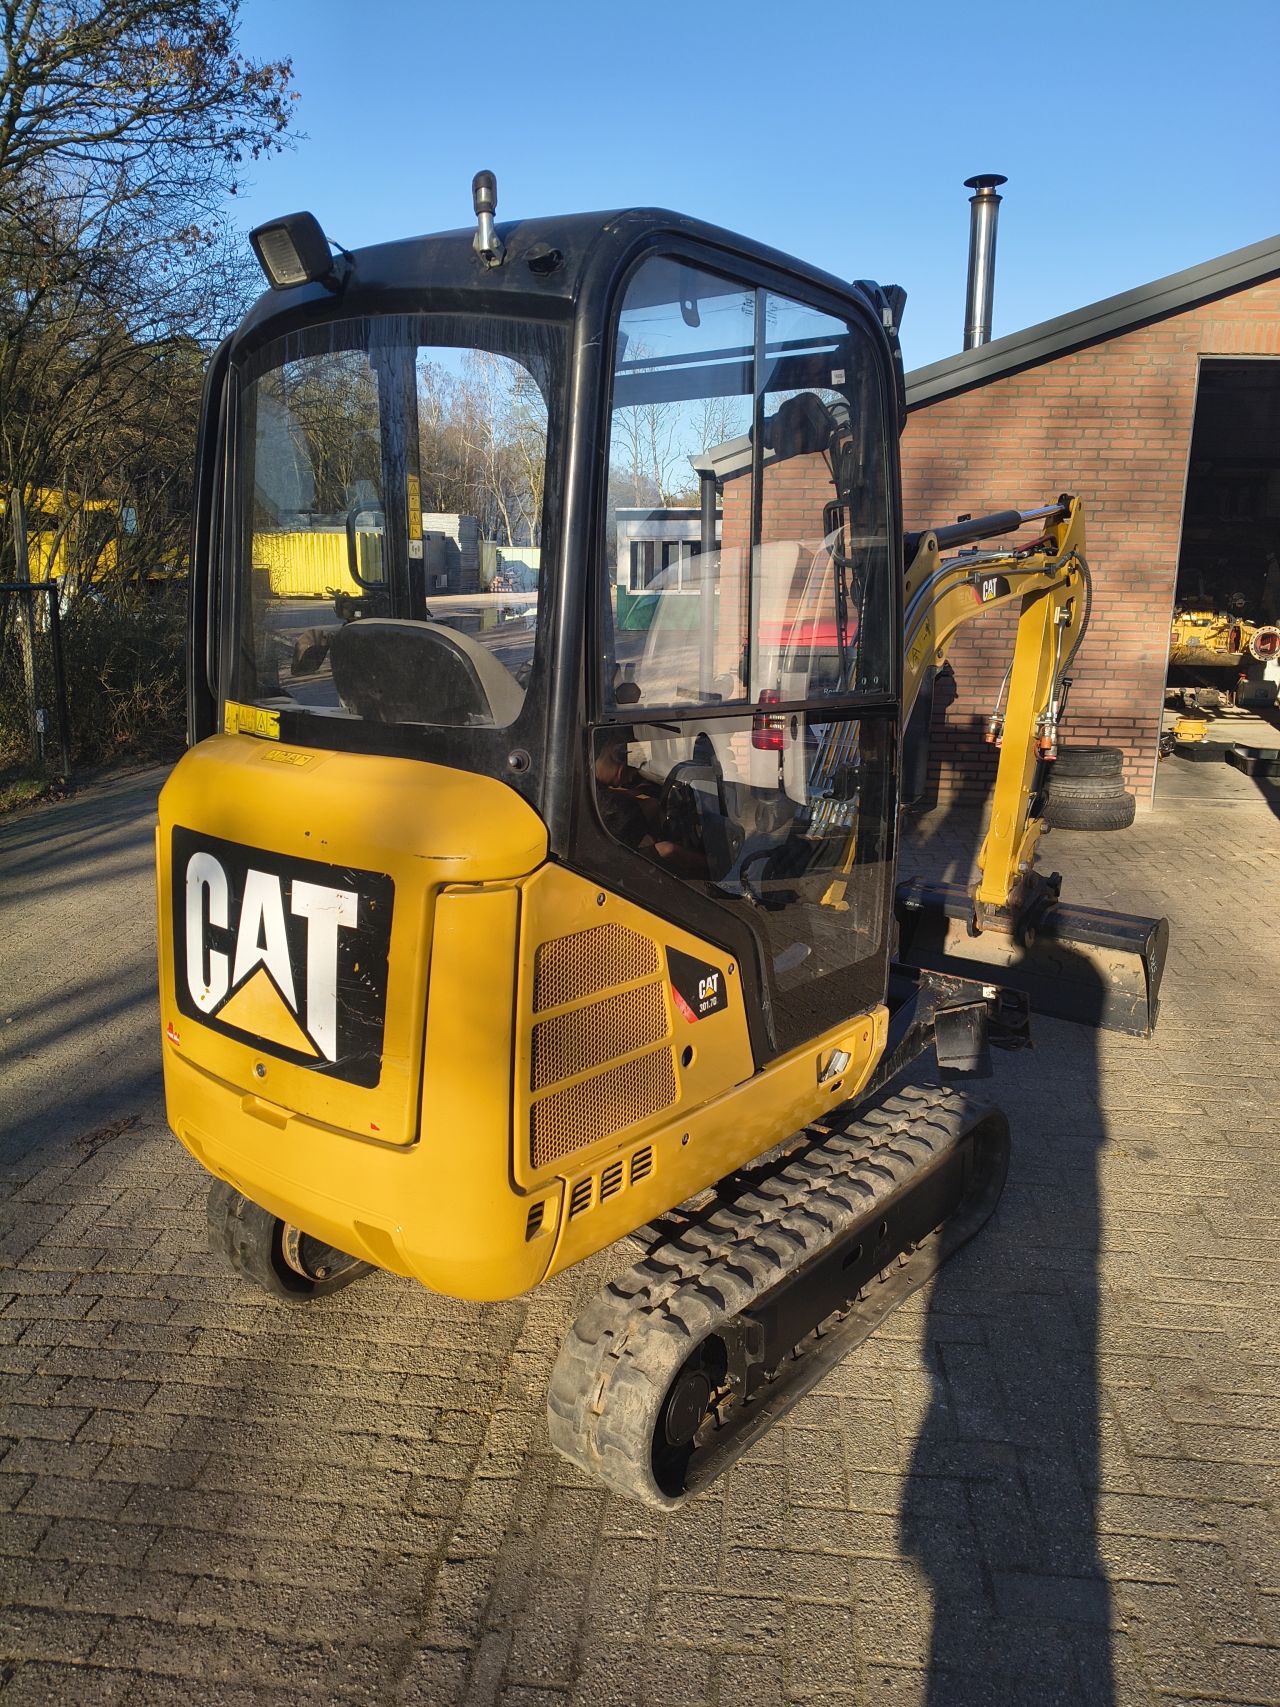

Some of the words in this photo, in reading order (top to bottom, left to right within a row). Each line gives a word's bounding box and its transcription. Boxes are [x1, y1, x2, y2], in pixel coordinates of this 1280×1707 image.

[983, 577, 998, 602] CAT
[186, 852, 358, 1062] CAT
[699, 973, 719, 999] CAT
